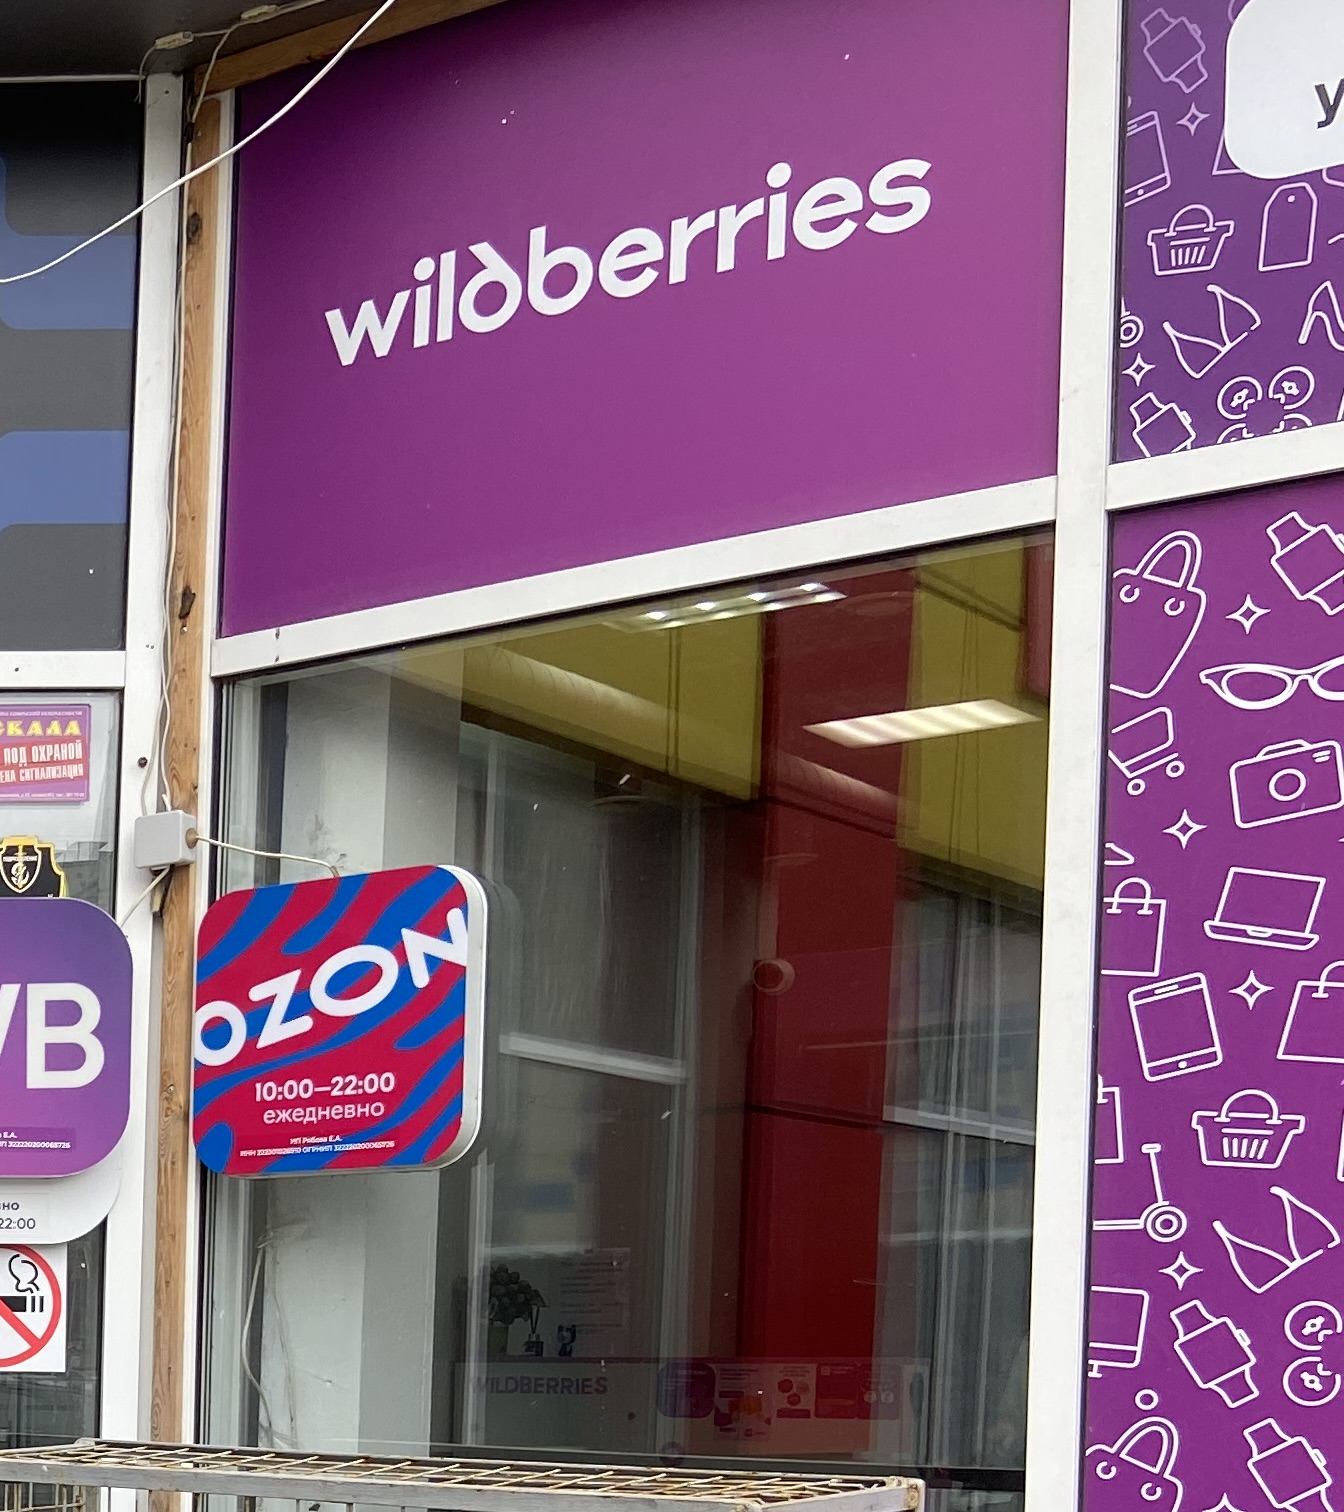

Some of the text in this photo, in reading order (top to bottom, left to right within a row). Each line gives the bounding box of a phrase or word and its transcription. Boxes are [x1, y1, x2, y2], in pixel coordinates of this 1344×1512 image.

[324, 156, 933, 367] wildberries
[3, 746, 28, 767] ПОД
[31, 739, 83, 763] ОХРАНОЙ
[19, 763, 84, 782] СИГНАЛИЗАЦИЯ
[193, 906, 470, 1067] OZON
[263, 1101, 385, 1125] ежедневно
